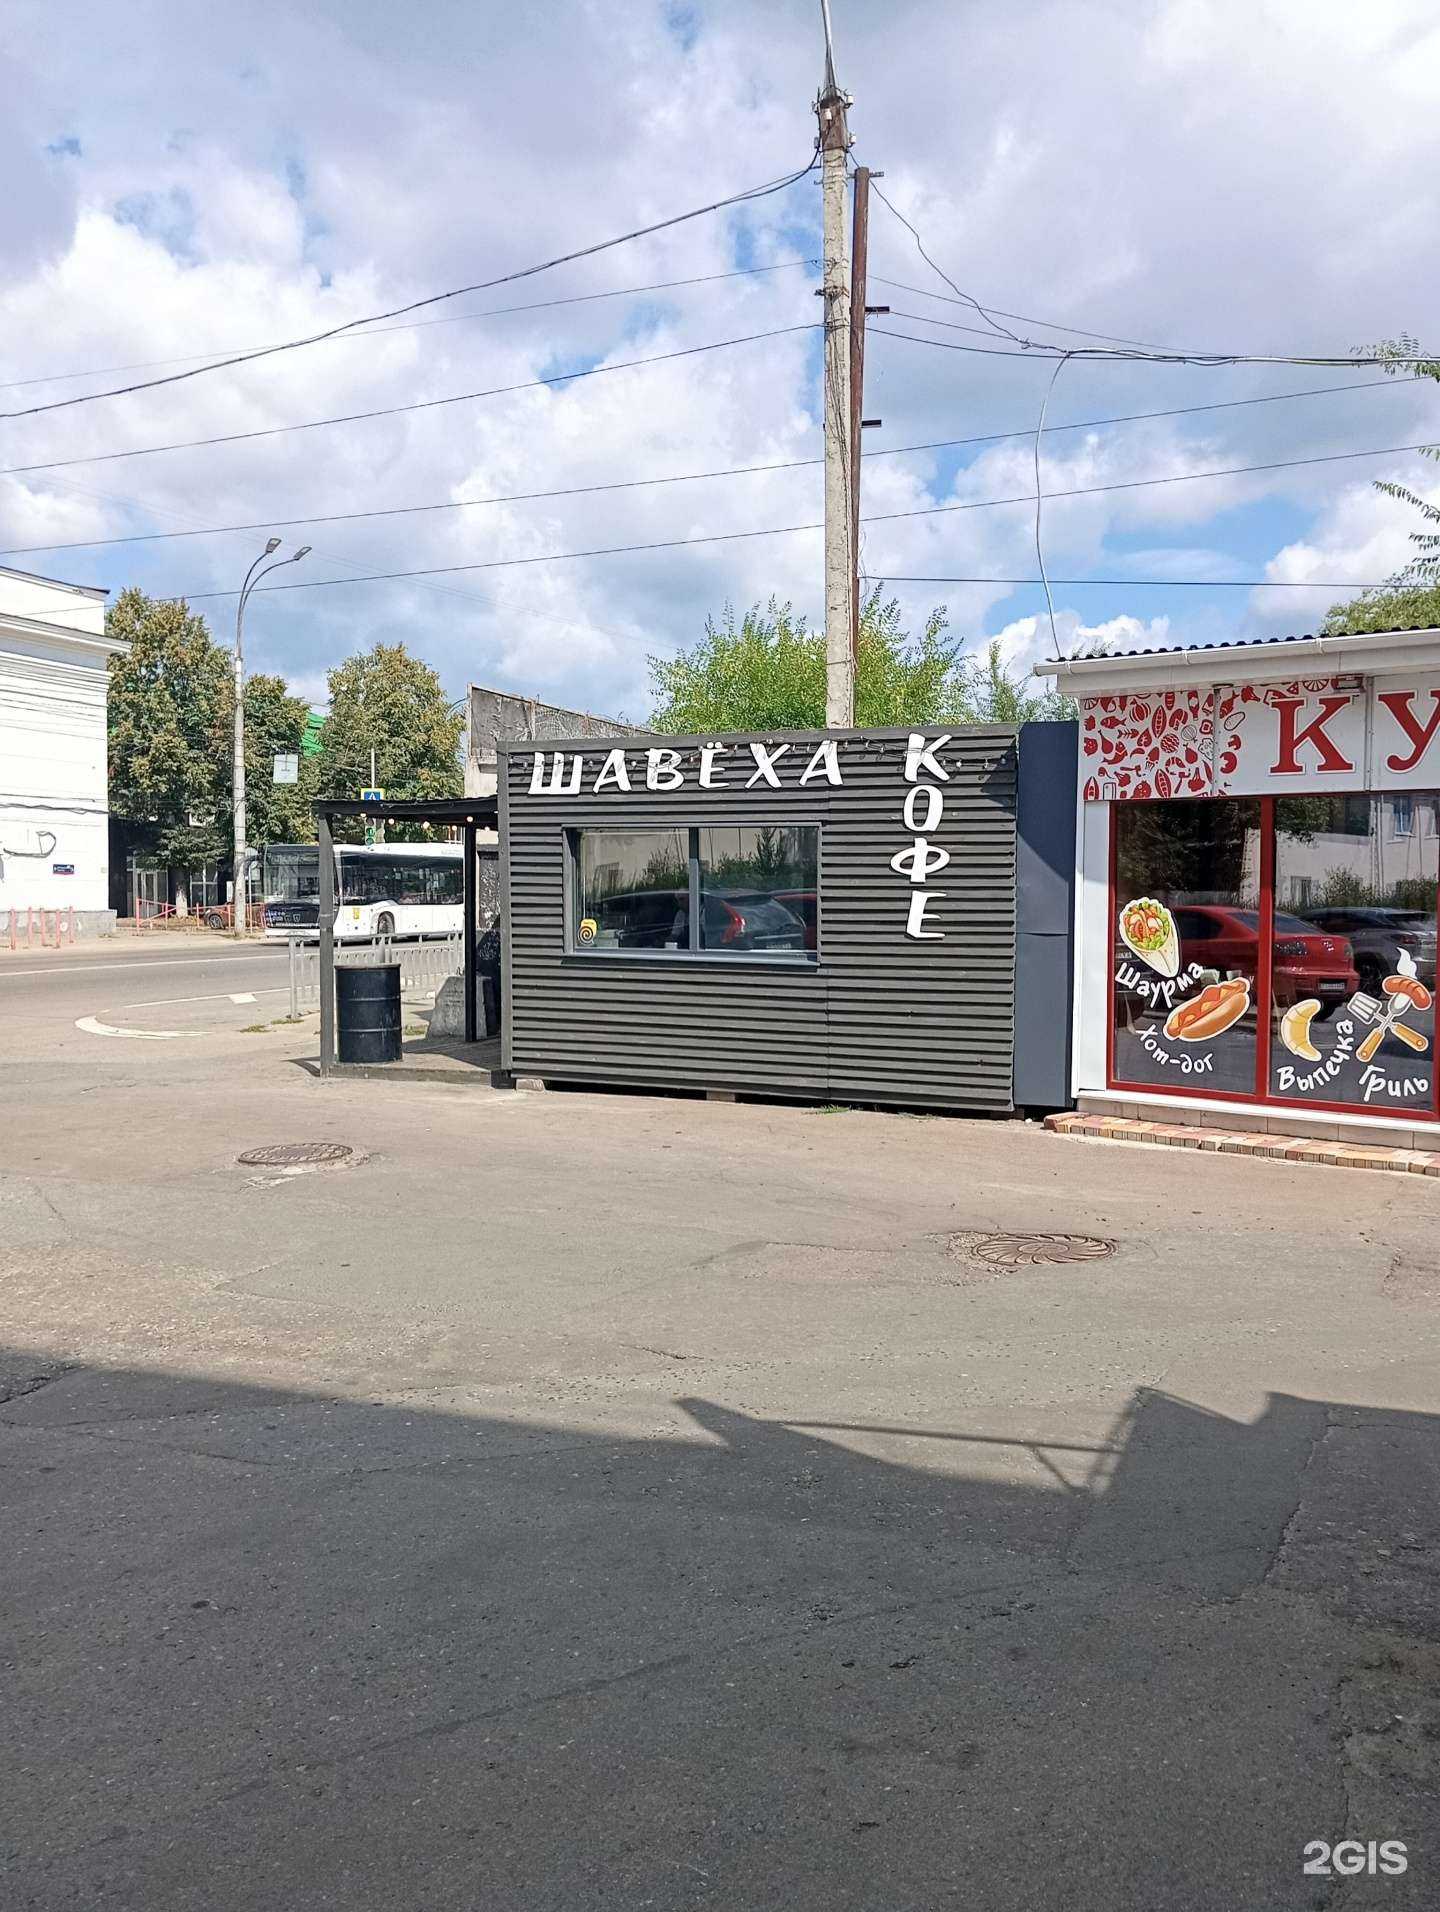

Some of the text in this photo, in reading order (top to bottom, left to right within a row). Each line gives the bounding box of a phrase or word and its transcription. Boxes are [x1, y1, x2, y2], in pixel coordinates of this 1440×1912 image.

[528, 740, 843, 795] ШАВЁХА
[890, 732, 951, 938] КОФЕ
[1115, 962, 1204, 1008] Шаурма
[1276, 1019, 1354, 1091] Выпечка
[1358, 1065, 1429, 1102] Гриль
